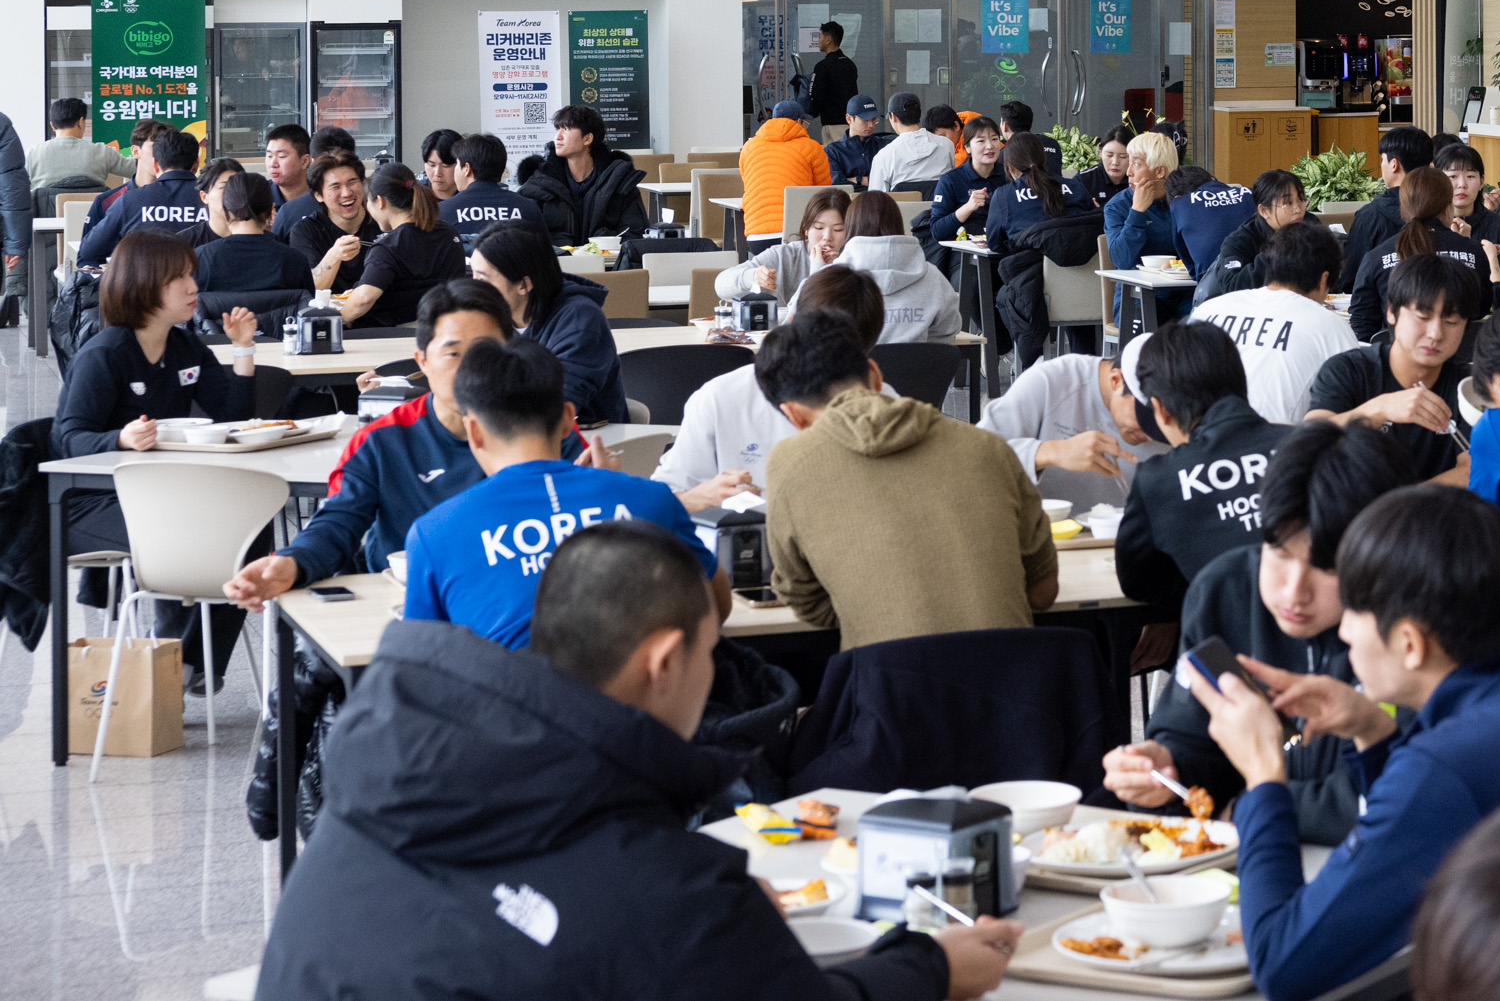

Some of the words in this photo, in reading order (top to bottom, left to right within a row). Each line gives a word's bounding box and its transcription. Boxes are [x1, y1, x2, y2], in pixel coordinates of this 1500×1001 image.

[990, 0, 1011, 12] It's
[1098, 1, 1116, 13] It's
[496, 19, 516, 27] Team
[517, 18, 541, 27] Korea
[997, 13, 1023, 24] Our
[1104, 13, 1127, 24] Our
[583, 28, 607, 36] 최상의
[609, 28, 634, 36] 상태를
[988, 24, 1019, 36] Vibe
[1096, 25, 1124, 37] Vibe
[129, 30, 170, 45] bibigo
[486, 32, 552, 46] 리커버리존
[578, 38, 595, 47] 위한
[596, 38, 620, 47] 최선의
[622, 38, 639, 46] 습관
[493, 48, 546, 61] 운영안내
[99, 66, 148, 80] 국가대표
[150, 65, 198, 79] 여러분의
[521, 70, 548, 78] 프로그램
[99, 83, 133, 96] 글로벌
[135, 84, 162, 95] No.1
[164, 82, 198, 95] 도전을
[506, 83, 534, 91] 운영시간
[99, 100, 197, 121] 응원합니다!
[1190, 186, 1252, 204] KOREA
[1204, 196, 1243, 208] HOCKEY
[142, 206, 209, 222] KOREA
[456, 206, 522, 223] KOREA
[1178, 449, 1277, 501] KOR
[1217, 493, 1262, 521] HOC
